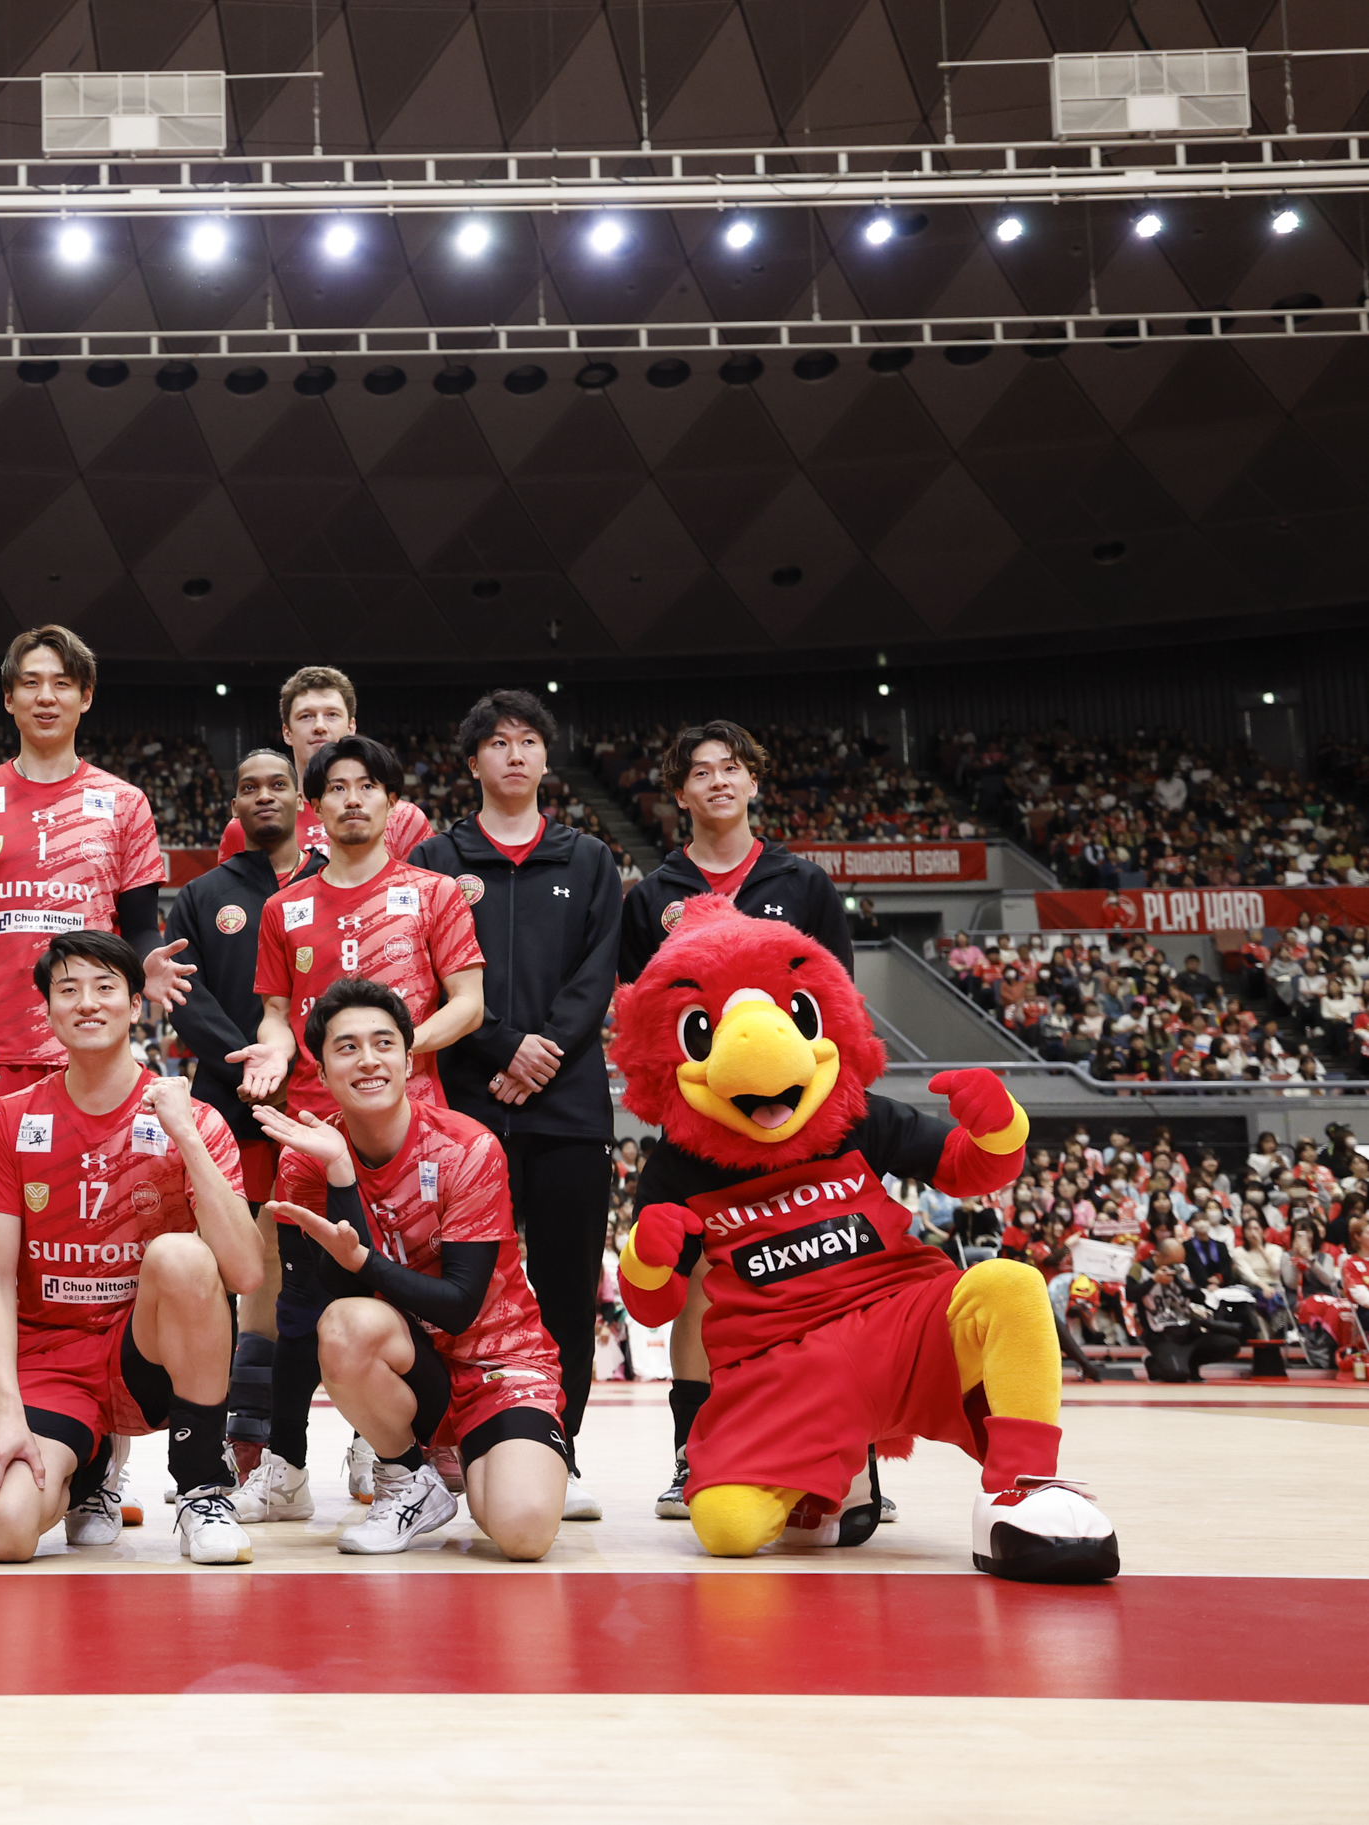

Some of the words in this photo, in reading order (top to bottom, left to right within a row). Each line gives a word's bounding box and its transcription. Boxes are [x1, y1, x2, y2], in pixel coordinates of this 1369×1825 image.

[37, 831, 47, 861] 1
[845, 850, 912, 875] SUNBIRDS
[914, 849, 960, 874] OSAKA
[14, 913, 40, 923] Chuo
[43, 913, 82, 926] Nittochi
[1143, 893, 1200, 931] PLAY
[1205, 892, 1266, 930] HARD
[341, 938, 359, 971] 8
[145, 1127, 156, 1141] 生
[78, 1181, 109, 1220] 17
[704, 1173, 865, 1237] SUNTORY
[28, 1239, 152, 1264] SUNTOR
[63, 1281, 92, 1292] Chuo
